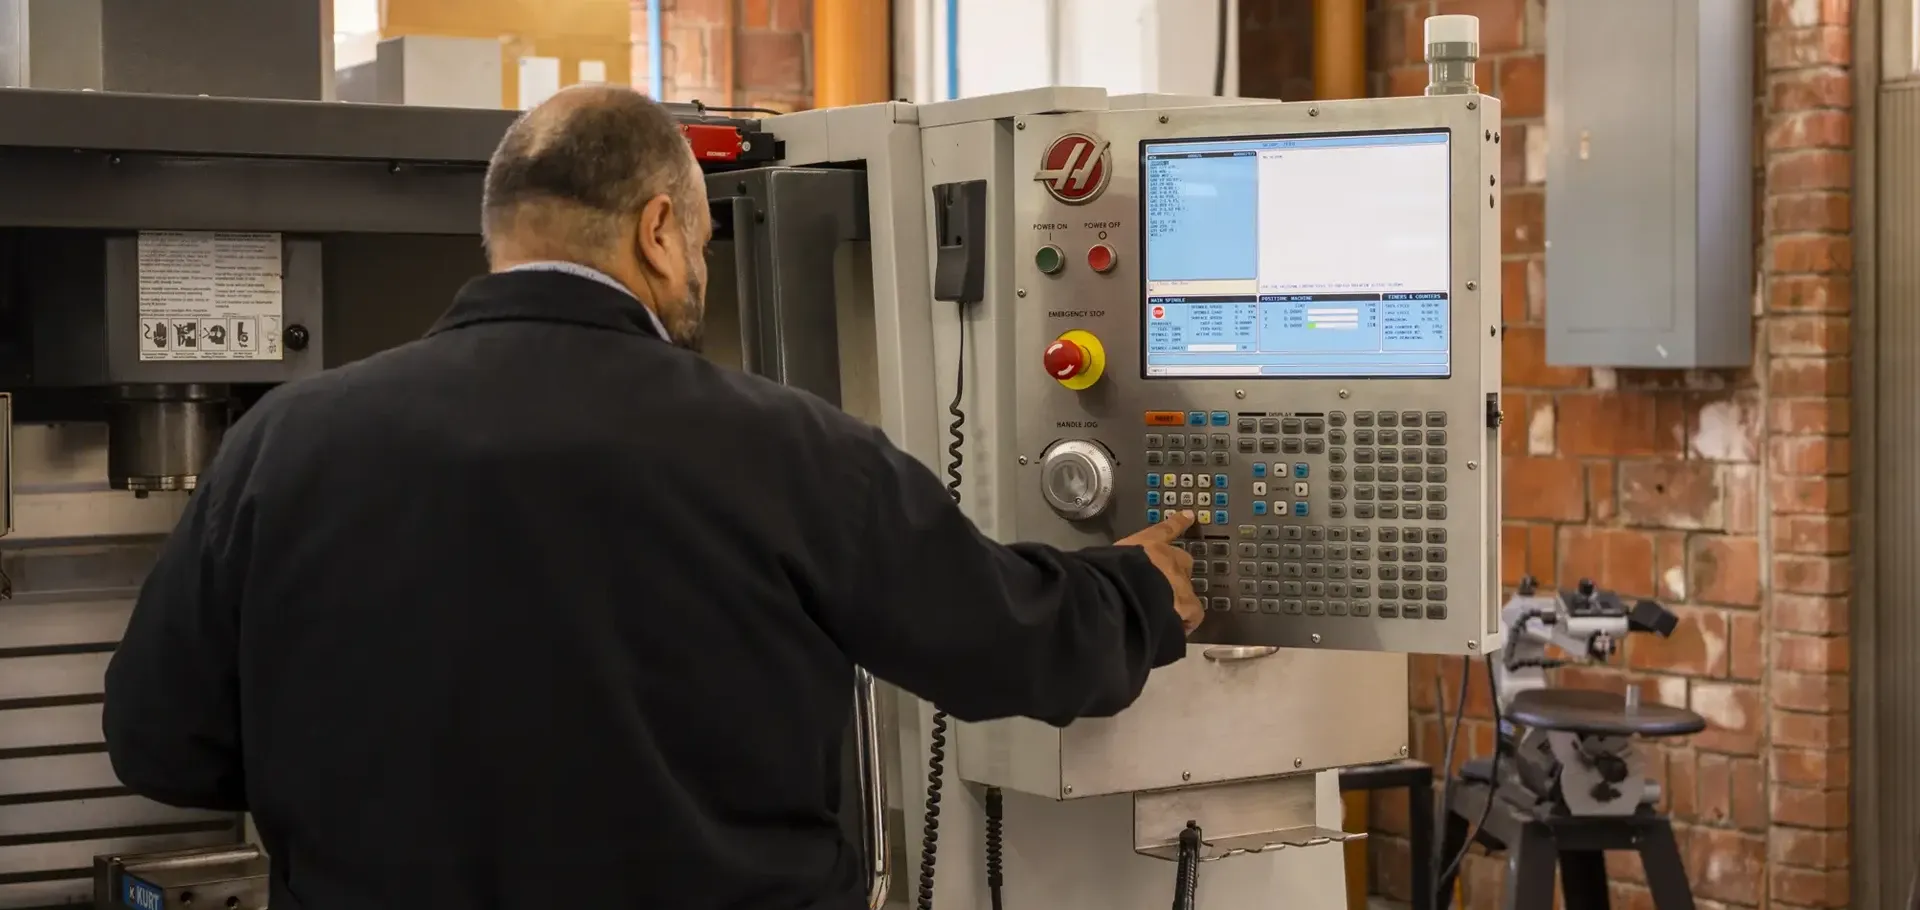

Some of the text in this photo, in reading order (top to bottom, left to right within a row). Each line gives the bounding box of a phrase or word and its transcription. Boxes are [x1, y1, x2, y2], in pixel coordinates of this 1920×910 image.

[1108, 221, 1121, 229] OFF
[1048, 310, 1088, 318] EMERGENCY
[136, 885, 159, 910] KURT
